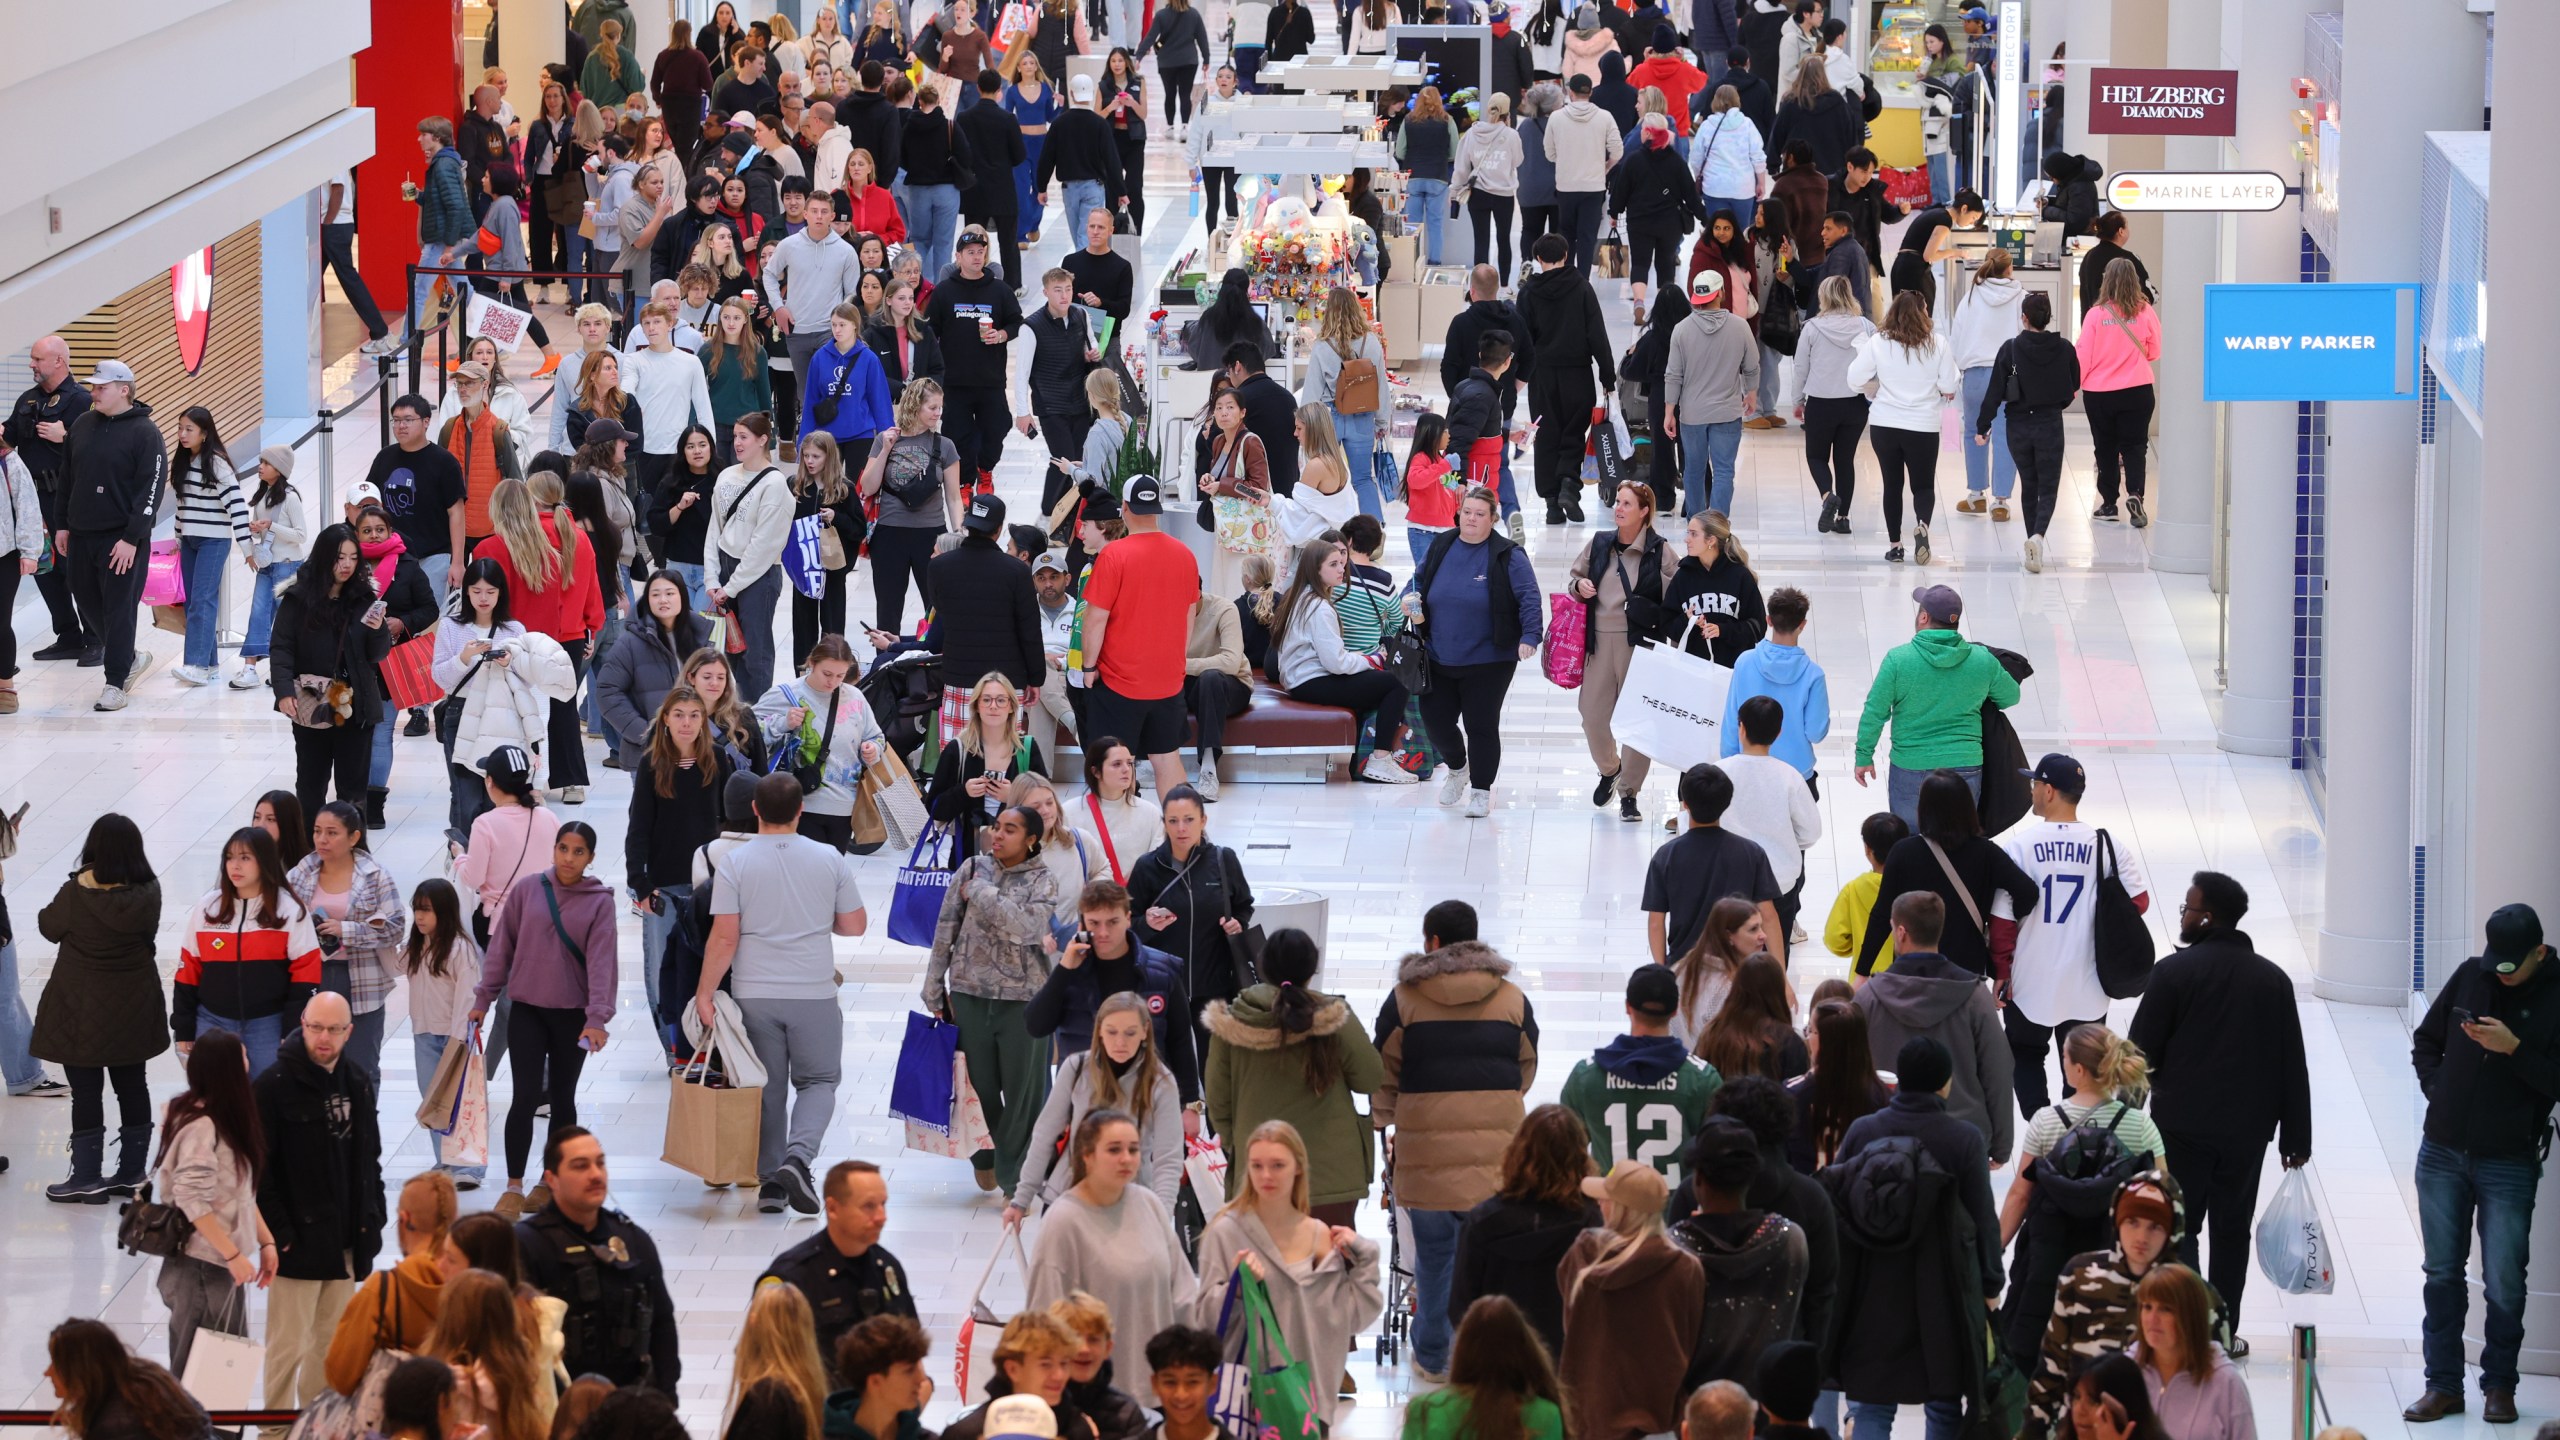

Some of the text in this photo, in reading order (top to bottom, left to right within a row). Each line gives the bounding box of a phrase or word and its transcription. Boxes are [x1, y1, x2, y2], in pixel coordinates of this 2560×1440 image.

[2005, 6, 2017, 81] DIRECTORY
[2101, 86, 2225, 106] HELZBERG
[2122, 105, 2205, 119] DIAMONDS
[1473, 151, 1507, 162] WTE
[2145, 186, 2275, 199] MARINE LAYER
[956, 311, 990, 319] patagonia
[2225, 336, 2376, 351] WARBY PARKER
[1681, 592, 1740, 619] ARK
[1642, 696, 1716, 728] THE SUPER PUFF
[2034, 841, 2093, 864] OHTANI
[2042, 874, 2085, 924] 17
[1604, 1103, 1683, 1190] 12
[2303, 1221, 2319, 1289] macy's
